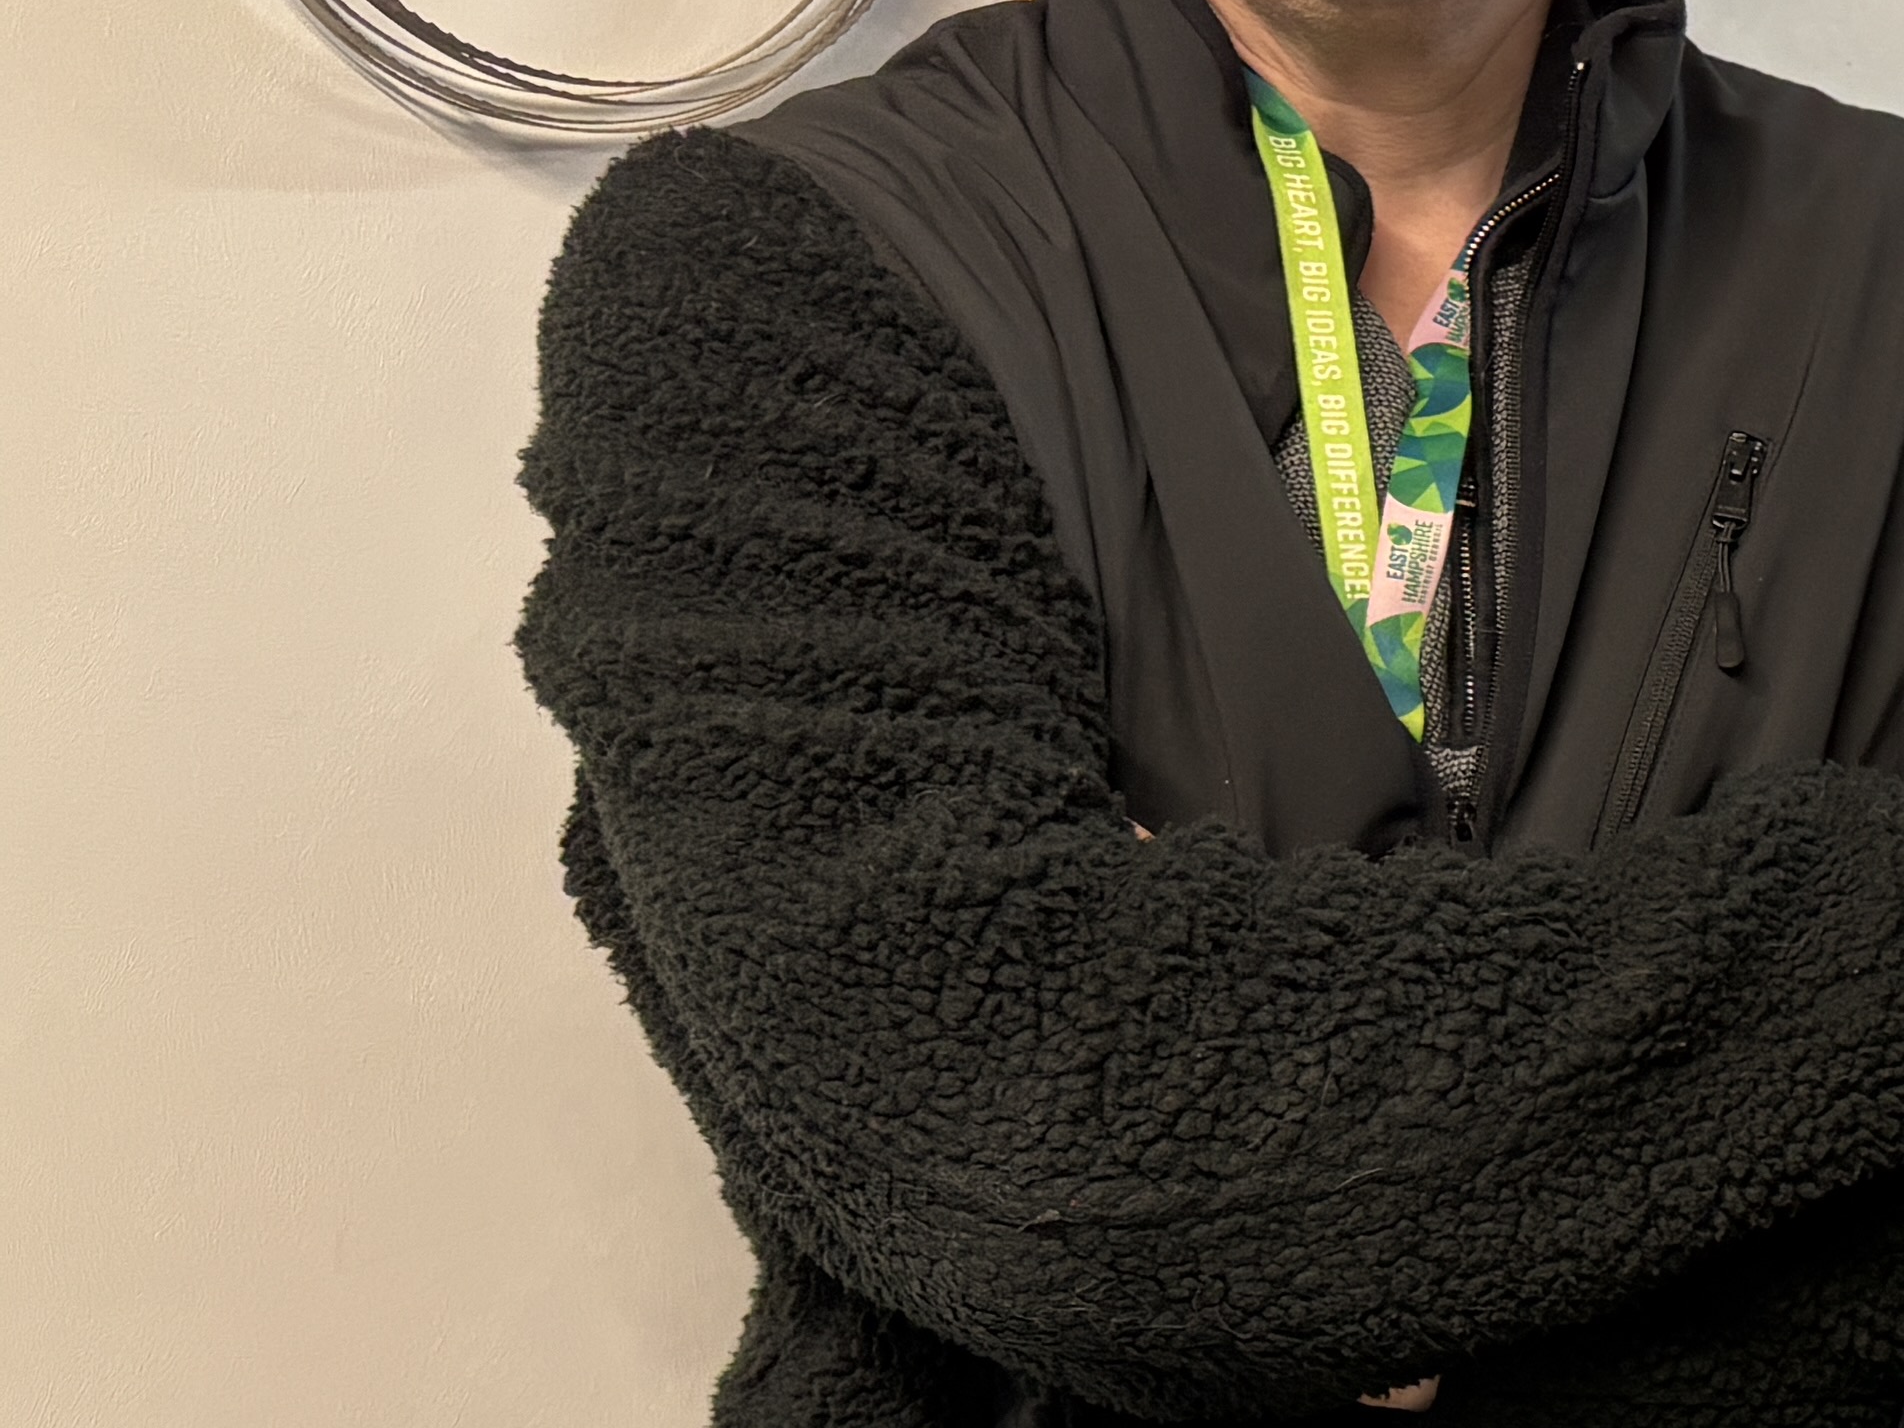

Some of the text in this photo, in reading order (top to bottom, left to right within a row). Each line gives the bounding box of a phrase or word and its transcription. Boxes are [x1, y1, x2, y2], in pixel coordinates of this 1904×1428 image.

[1432, 297, 1460, 328] EAST
[1269, 135, 1372, 600] BIG HEART, BIG IDEAS, BIG DIFFERENCE!
[1386, 545, 1409, 581] EAST
[1401, 519, 1434, 604] HAMPSHIRE
